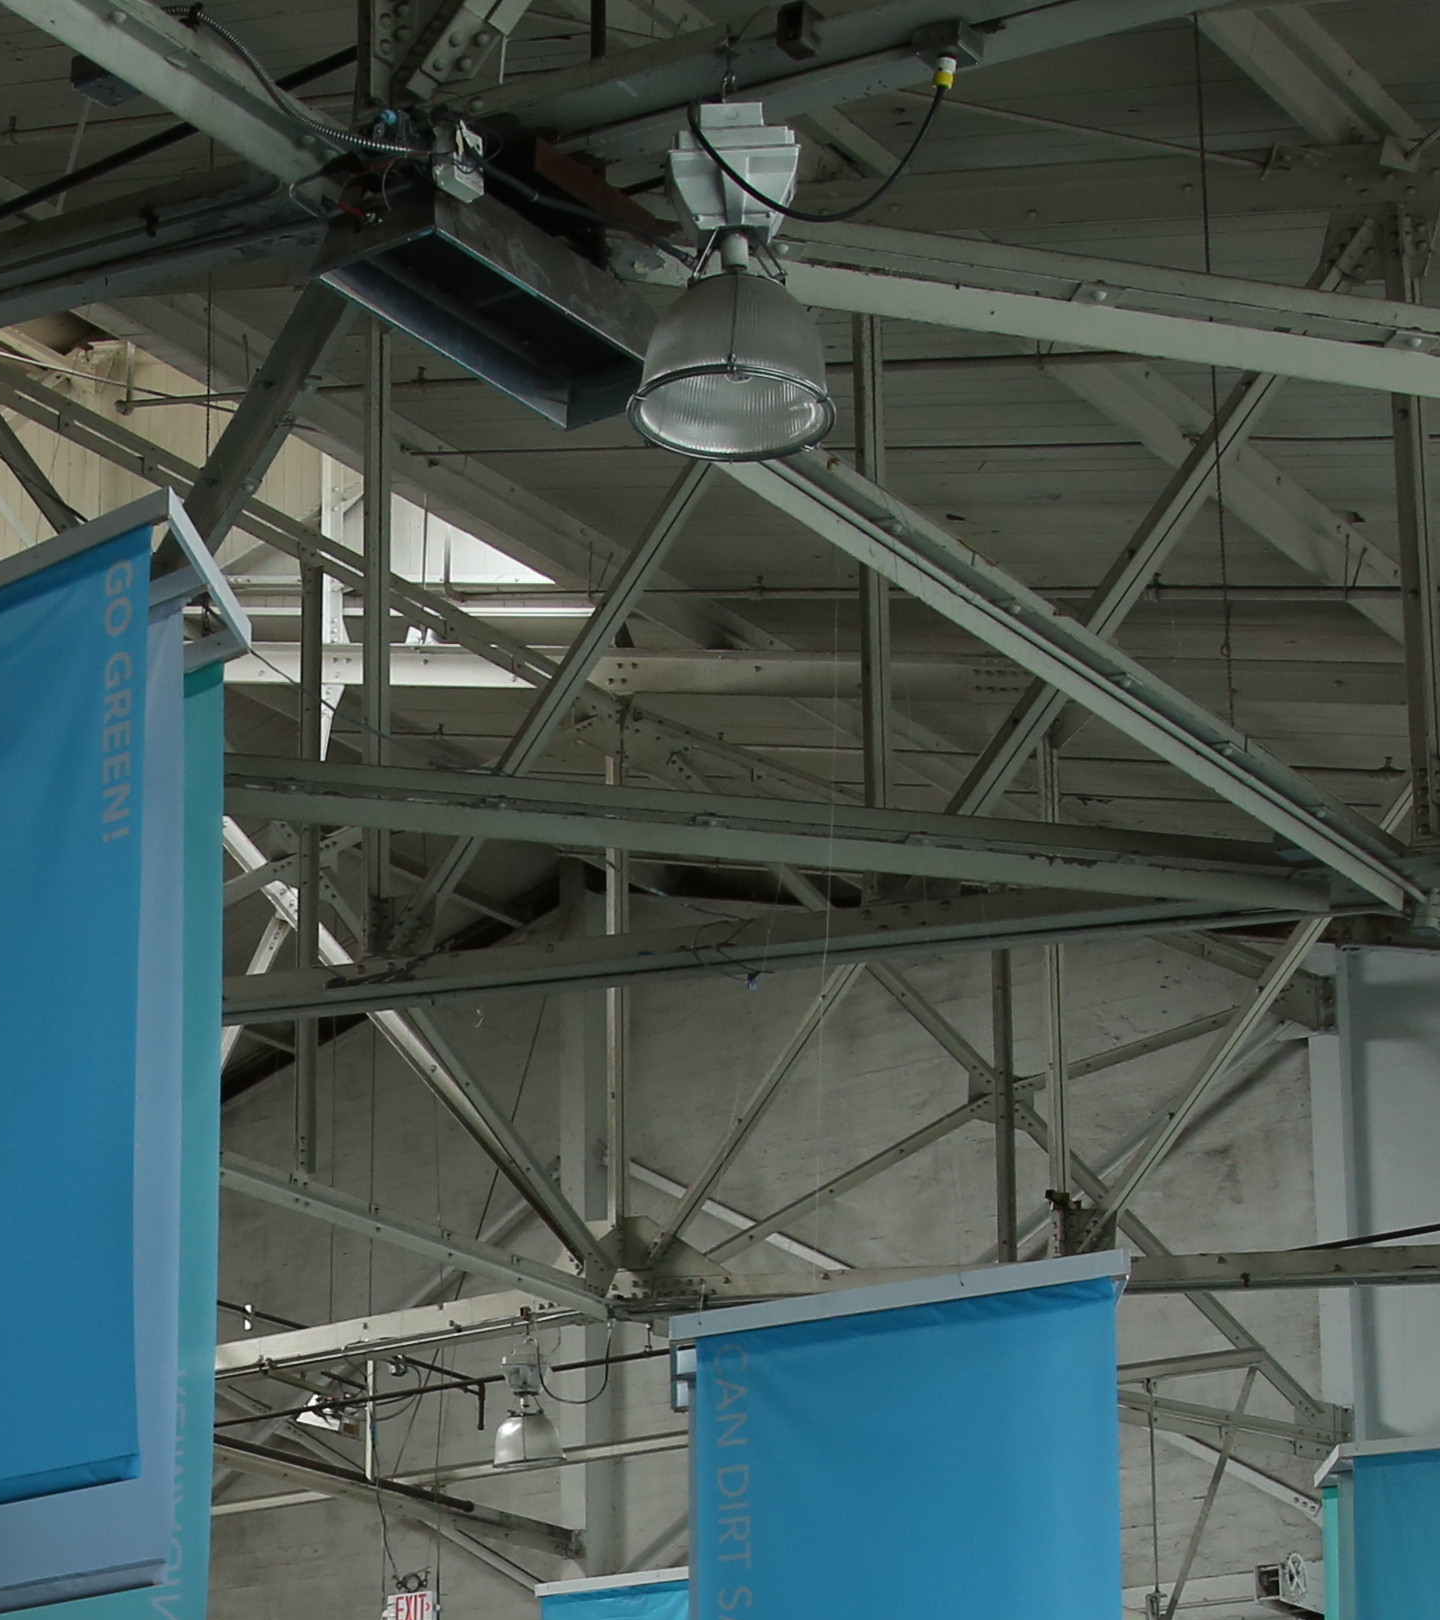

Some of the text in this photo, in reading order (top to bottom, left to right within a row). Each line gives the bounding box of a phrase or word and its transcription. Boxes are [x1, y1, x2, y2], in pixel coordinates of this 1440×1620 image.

[102, 560, 133, 842] GO GREEN!
[716, 1340, 748, 1449] CAN
[717, 1465, 752, 1572] DIRT
